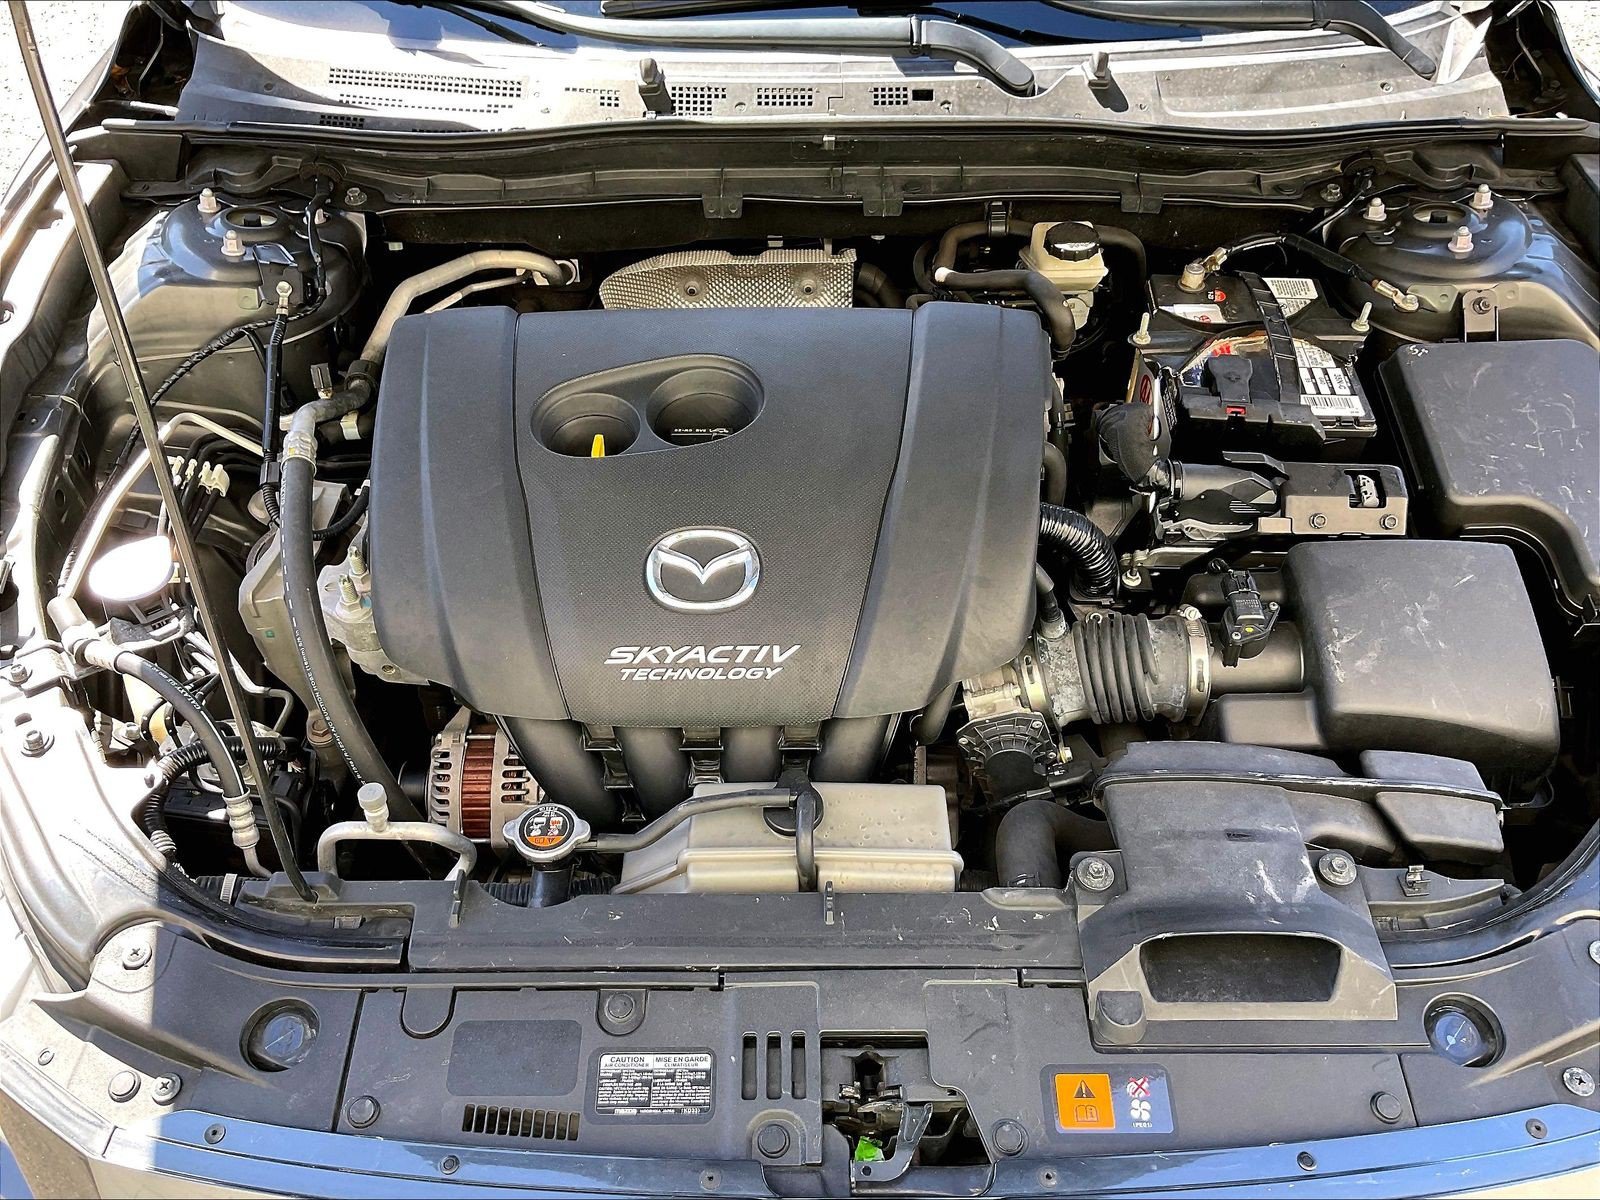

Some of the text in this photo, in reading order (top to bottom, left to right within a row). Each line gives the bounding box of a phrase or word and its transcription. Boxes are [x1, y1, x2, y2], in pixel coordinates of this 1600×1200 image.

[604, 644, 800, 665] SKYACTIV
[615, 666, 784, 681] TECHNOLOGY
[175, 686, 201, 710] GALAXY
[315, 692, 331, 721] SUCTION
